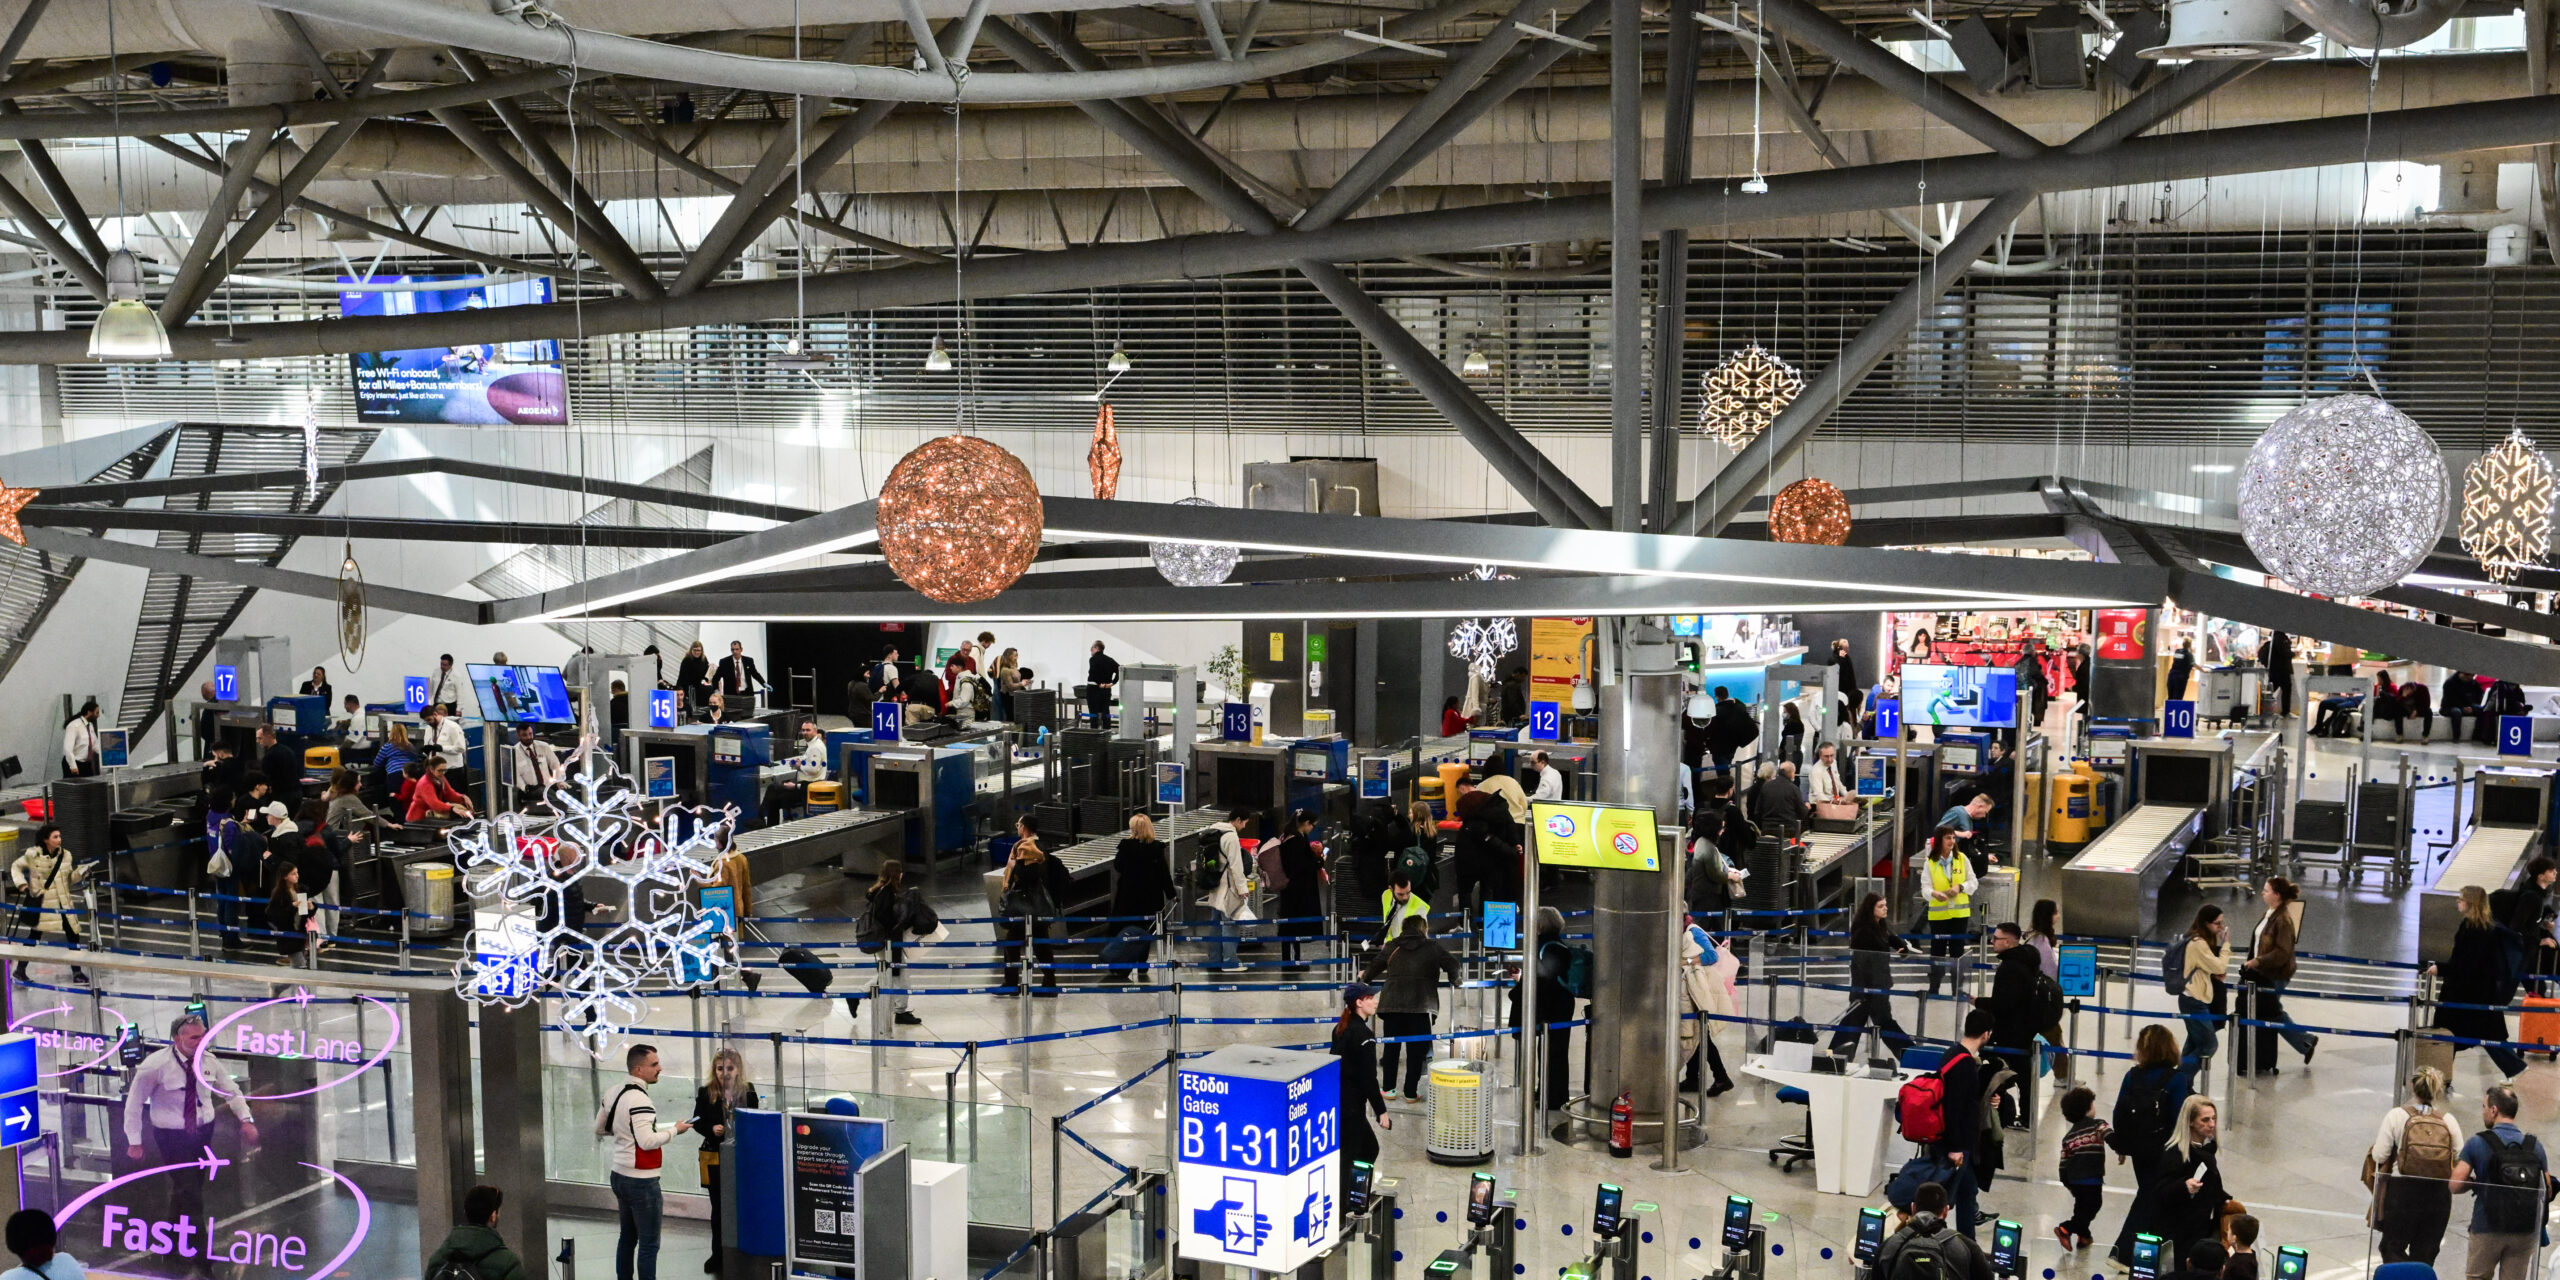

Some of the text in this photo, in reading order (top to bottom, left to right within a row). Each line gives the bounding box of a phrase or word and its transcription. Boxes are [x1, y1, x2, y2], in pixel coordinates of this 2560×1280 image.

[356, 367, 441, 379] Free Wi-Fi onboard,
[358, 380, 371, 390] for
[371, 380, 382, 390] all
[383, 380, 438, 390] Miles+Bonus
[360, 392, 376, 401] Enjoy
[399, 392, 409, 401] just
[517, 407, 552, 415] AEGEAN
[217, 674, 234, 692] 17
[407, 685, 425, 704] 16
[652, 699, 671, 719] 15
[2168, 709, 2190, 729] 10
[876, 712, 895, 732] 14
[1228, 713, 1247, 732] 13
[1533, 711, 1555, 731] 12
[2509, 726, 2522, 746] 9
[64, 1030, 105, 1053] Lane
[236, 1024, 362, 1063] Fast Lane
[1179, 1073, 1229, 1095] Έξοδοι
[1287, 1077, 1313, 1100] Έξοδοι
[1183, 1095, 1220, 1115] Gates
[1288, 1102, 1308, 1121] Gates
[1183, 1116, 1278, 1168] B 1-31
[1288, 1106, 1336, 1168] B 1-31
[102, 1204, 307, 1271] Fast Lane
